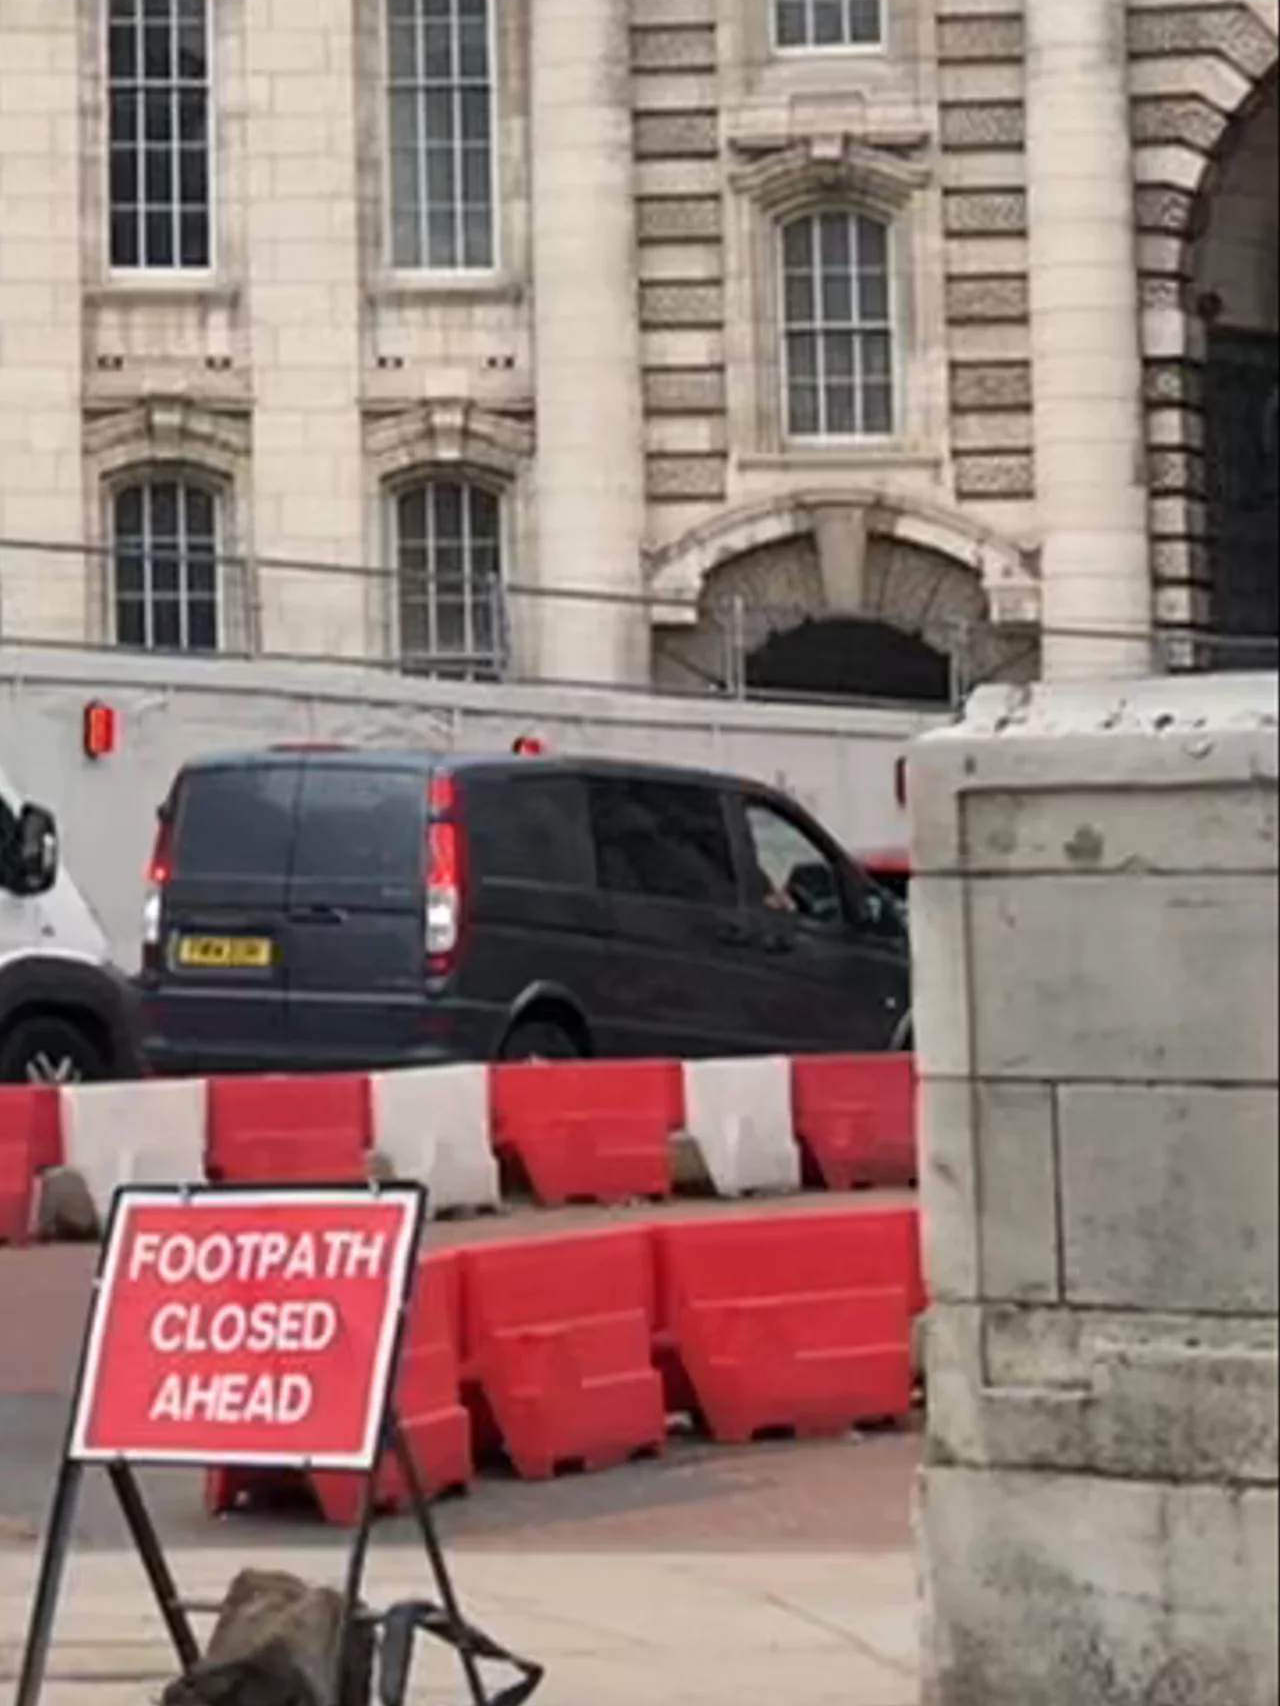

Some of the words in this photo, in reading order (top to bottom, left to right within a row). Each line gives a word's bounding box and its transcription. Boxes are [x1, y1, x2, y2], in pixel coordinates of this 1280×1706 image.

[129, 1231, 385, 1282] FOOTPATH
[151, 1302, 335, 1352] CLOSED
[149, 1372, 312, 1423] AHEAD
